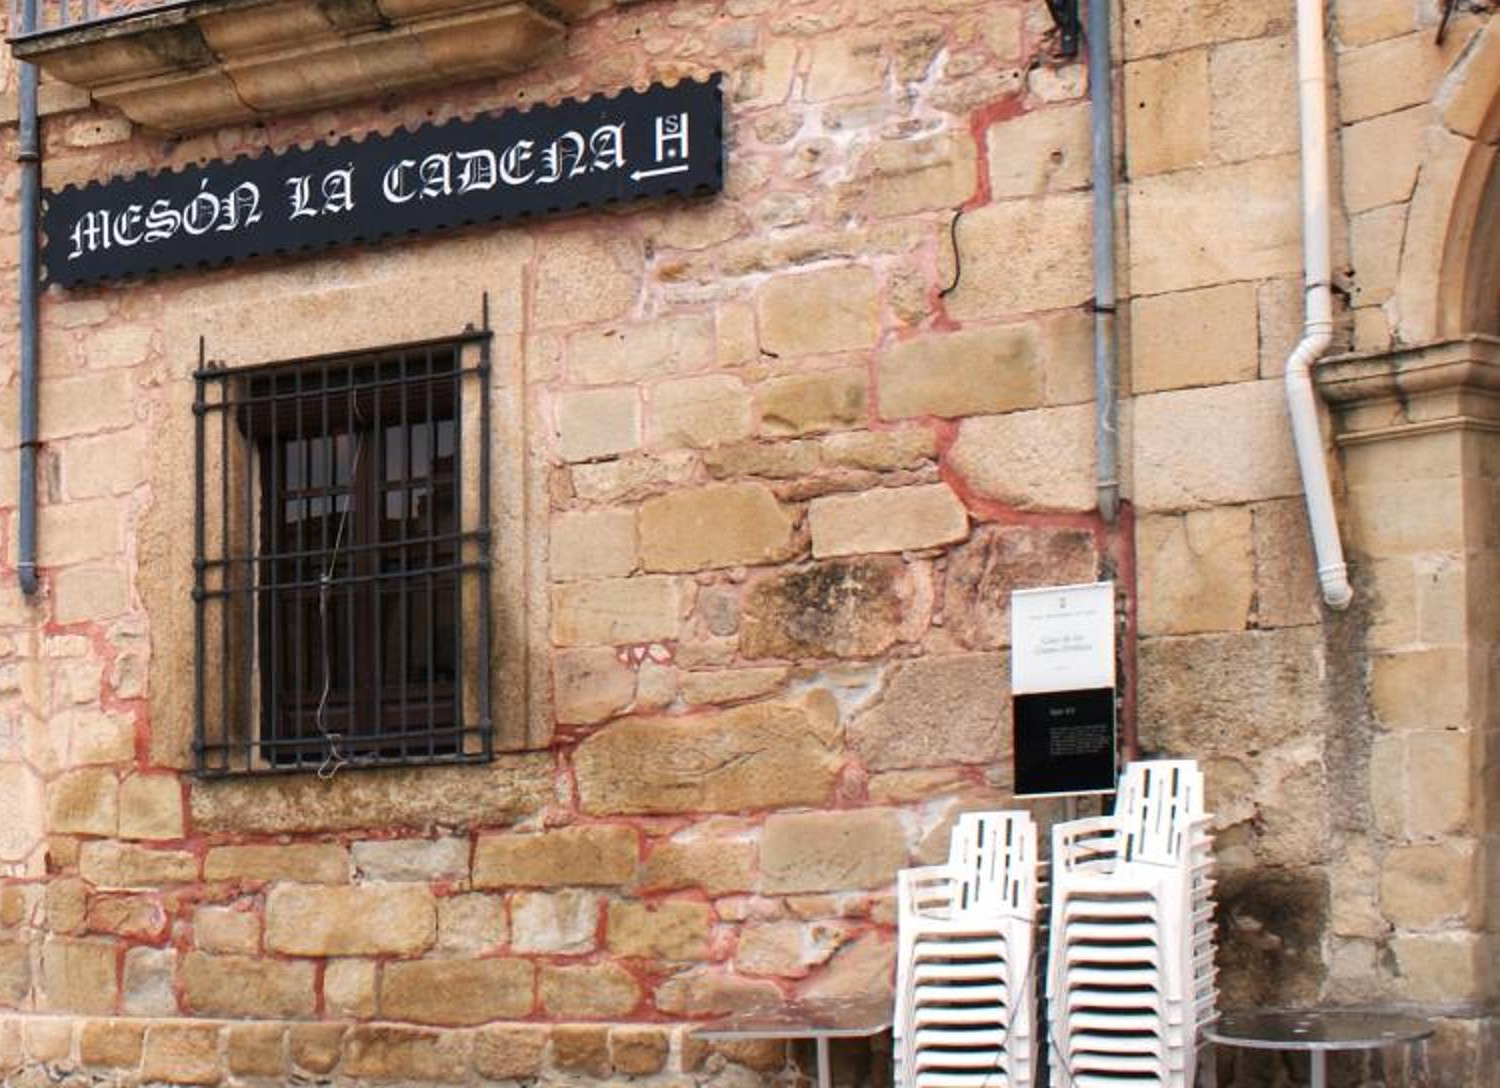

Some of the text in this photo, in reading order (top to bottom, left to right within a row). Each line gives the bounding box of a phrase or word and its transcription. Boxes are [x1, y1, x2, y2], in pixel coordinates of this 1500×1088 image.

[67, 177, 263, 261] MESÓN
[285, 161, 355, 221] LA
[382, 120, 627, 204] CADENA
